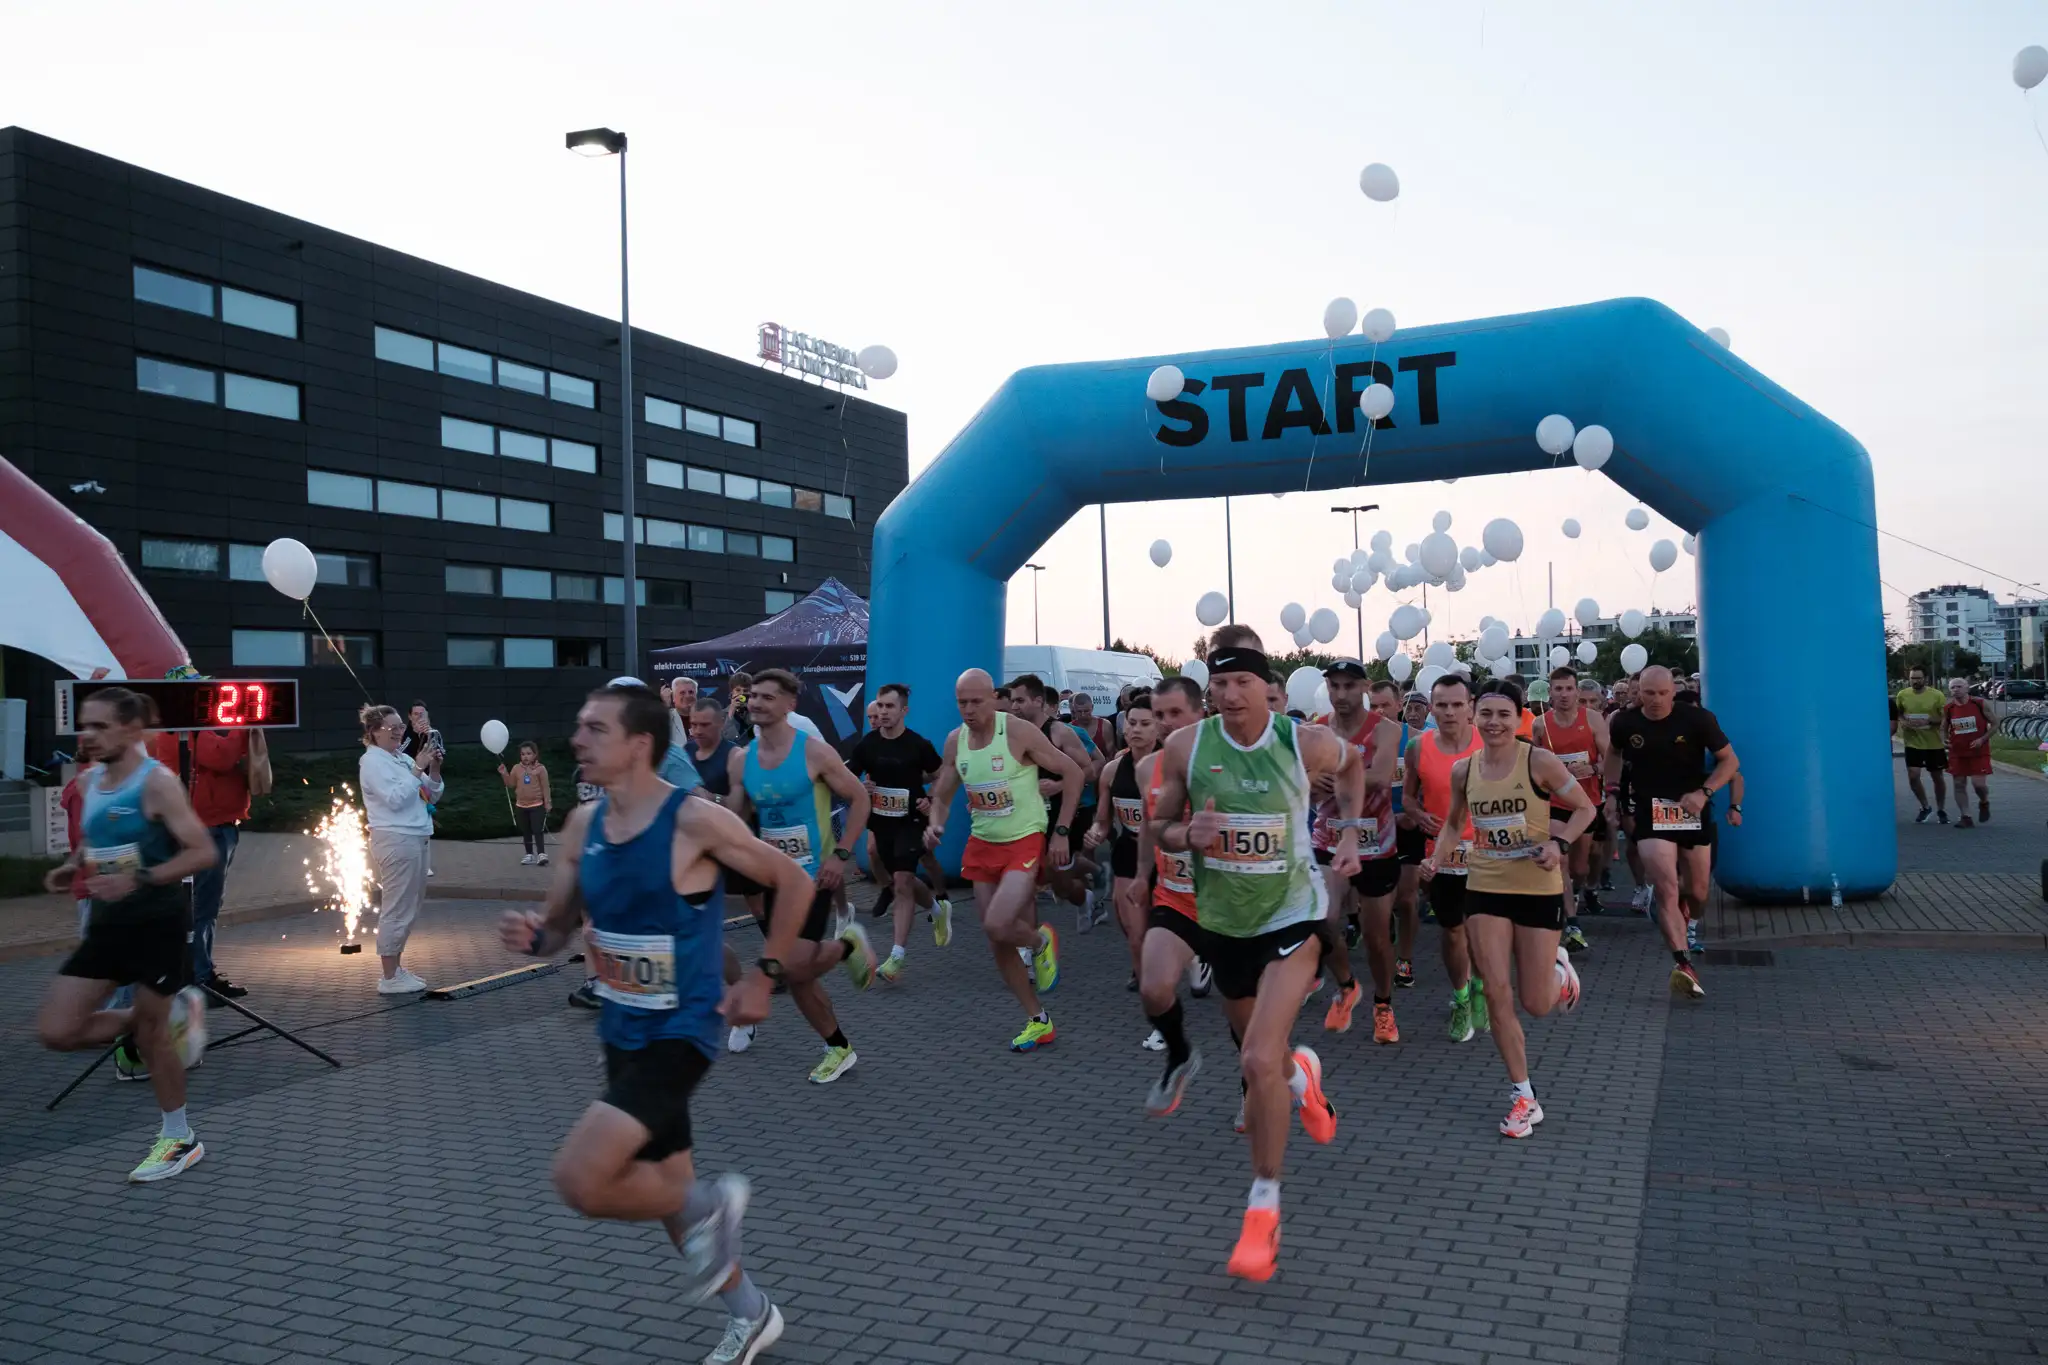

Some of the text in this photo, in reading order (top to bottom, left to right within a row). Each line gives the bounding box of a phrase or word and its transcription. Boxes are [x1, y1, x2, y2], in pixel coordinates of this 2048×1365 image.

[1156, 351, 1457, 447] START
[653, 661, 707, 671] elektroniczne
[882, 795, 895, 808] 31
[978, 791, 998, 806] 19
[1218, 830, 1269, 855] 150
[1487, 828, 1511, 847] 48
